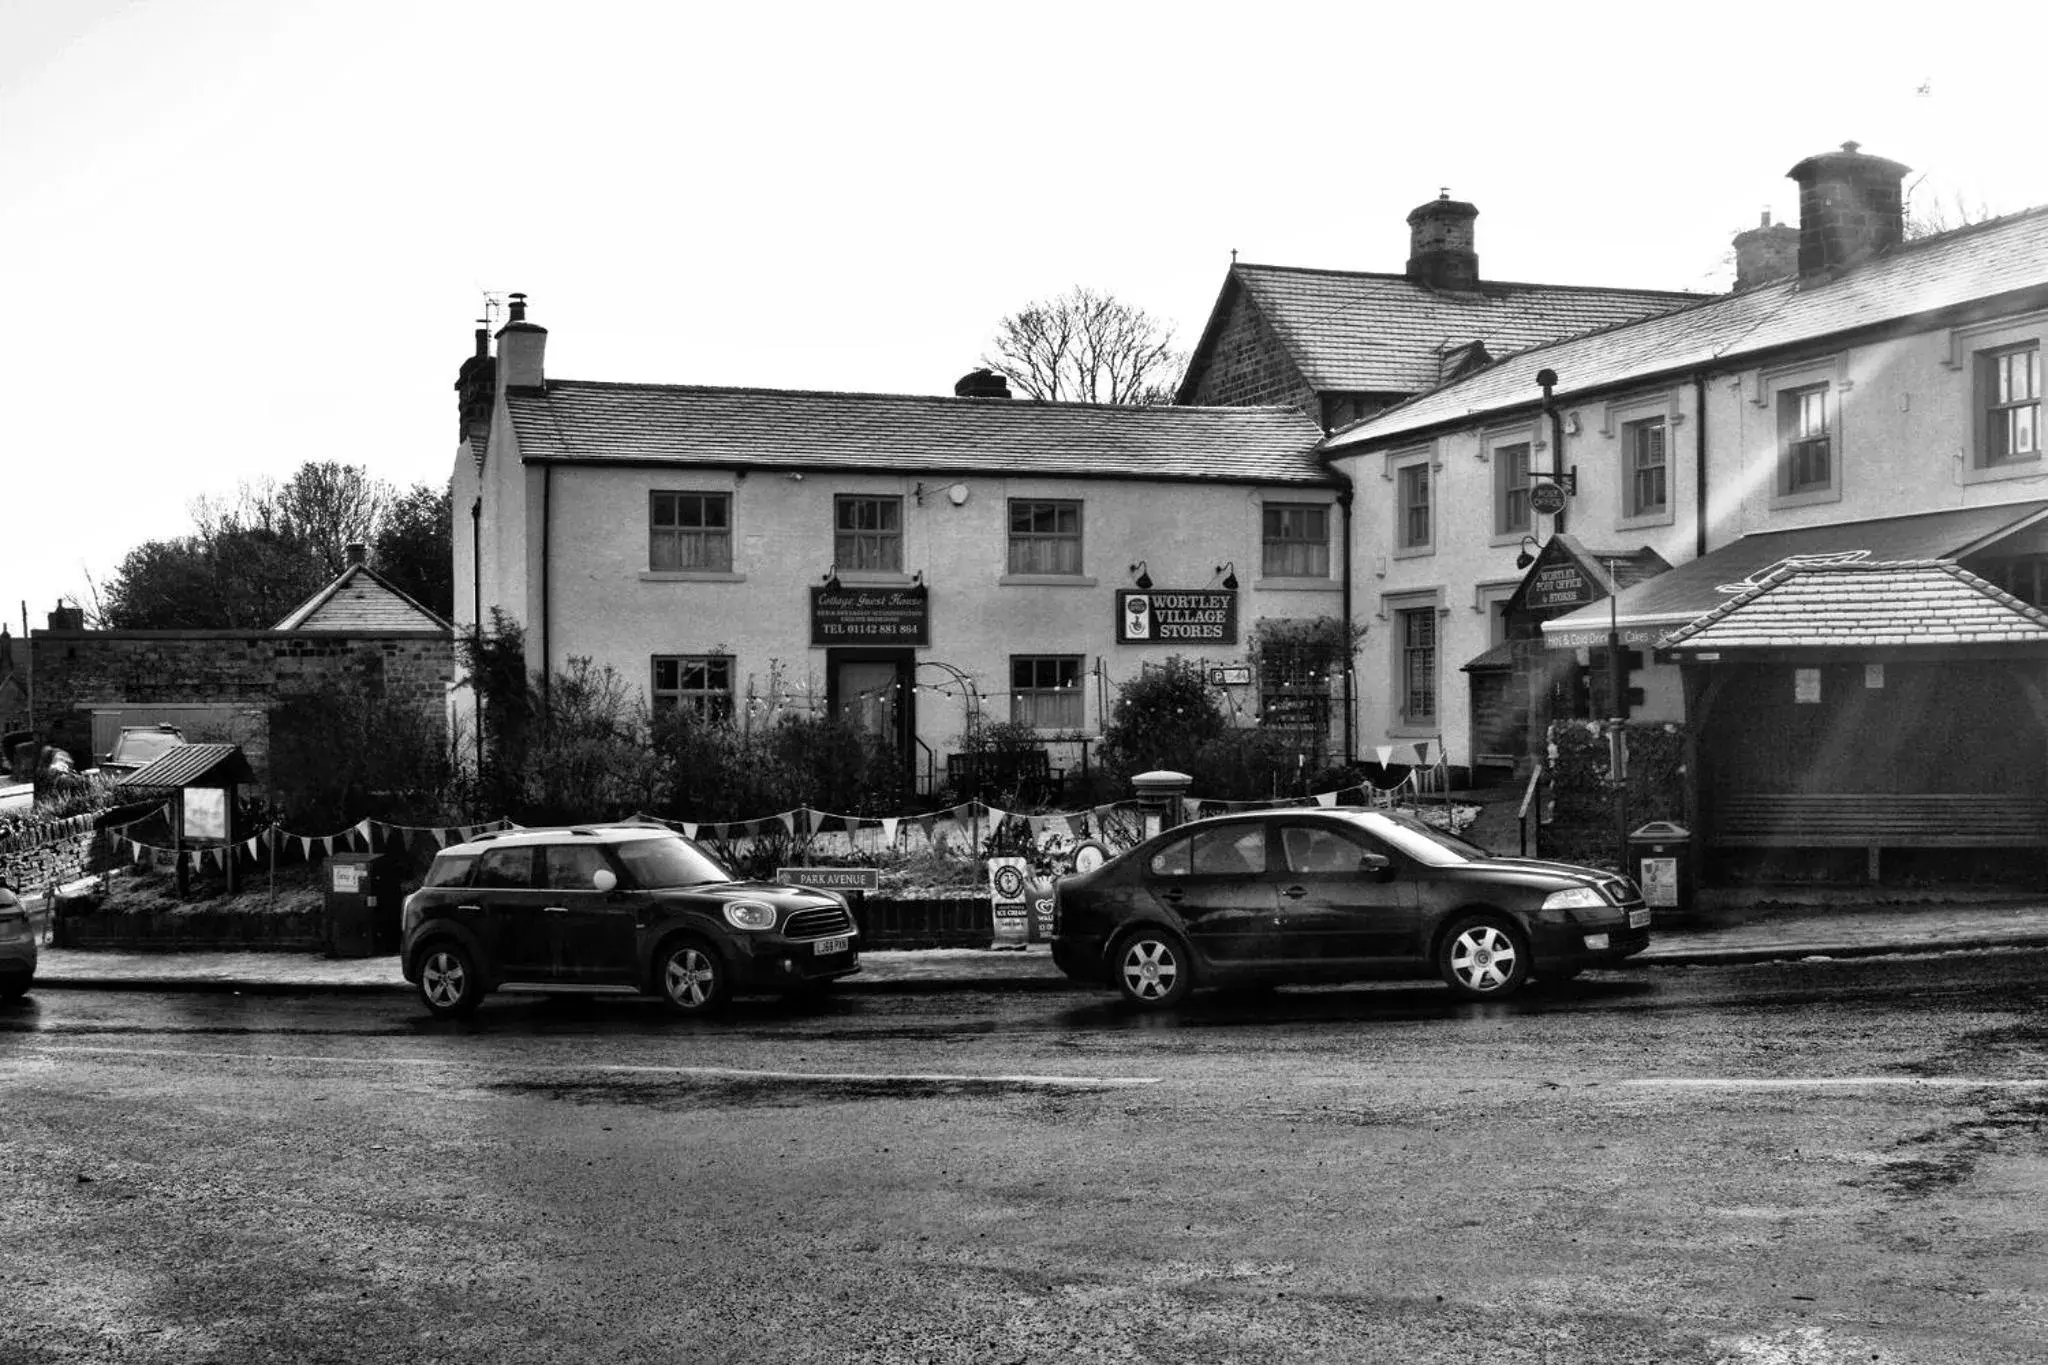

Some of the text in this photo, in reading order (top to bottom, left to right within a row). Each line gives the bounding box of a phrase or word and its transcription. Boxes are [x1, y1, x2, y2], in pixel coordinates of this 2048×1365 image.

[818, 592, 924, 608] Cottage Guest House
[1151, 595, 1231, 608] WORTLEY
[1155, 609, 1227, 623] VILLAGE
[823, 623, 846, 634] TEL
[847, 623, 877, 634] 01142
[879, 623, 897, 634] 881
[1160, 624, 1223, 638] STORES
[1571, 633, 1588, 645] Cold
[1590, 632, 1609, 644] Drin
[1625, 630, 1649, 642] Cakes
[800, 874, 866, 885] PARK AVENUE
